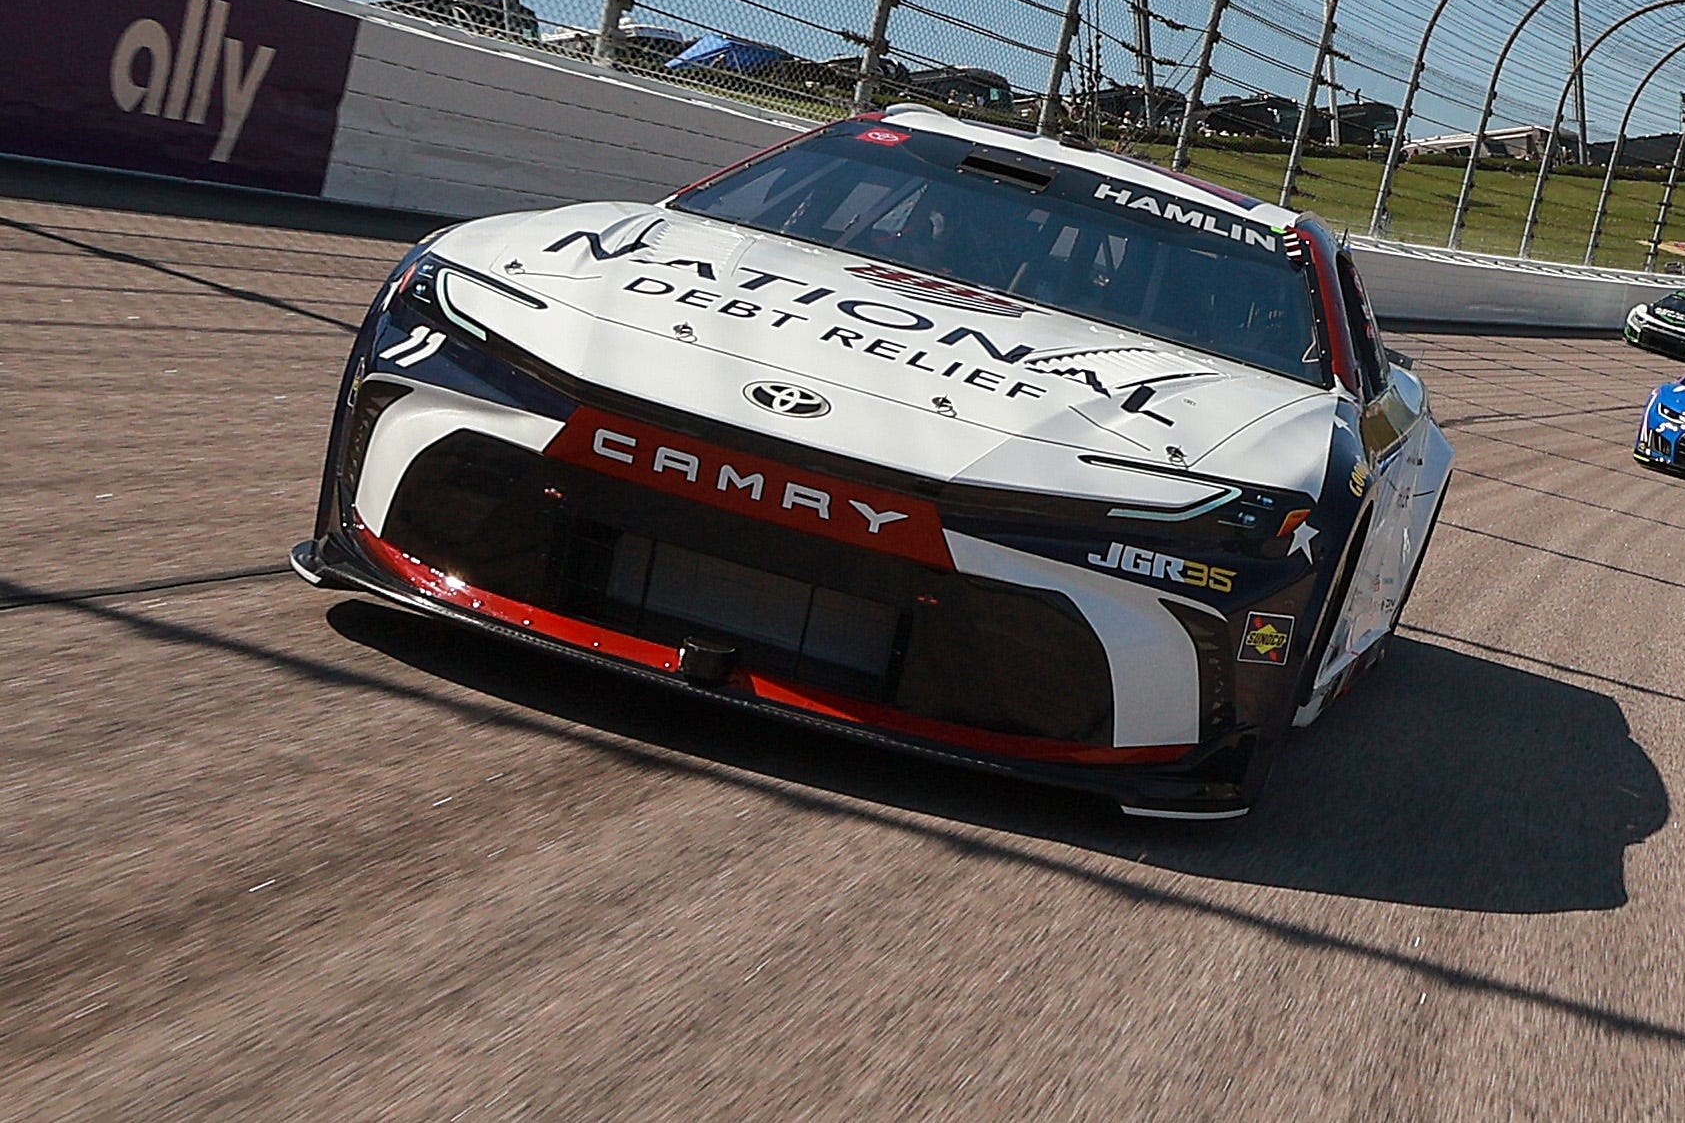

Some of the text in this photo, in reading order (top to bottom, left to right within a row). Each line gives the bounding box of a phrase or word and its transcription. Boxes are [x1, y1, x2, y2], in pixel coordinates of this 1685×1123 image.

[1094, 183, 1278, 253] HAMLIN
[378, 325, 448, 368] 11
[543, 218, 1175, 426] NATIONAL
[623, 276, 1048, 400] DEBT RELIEF
[593, 427, 909, 534] CAMRY
